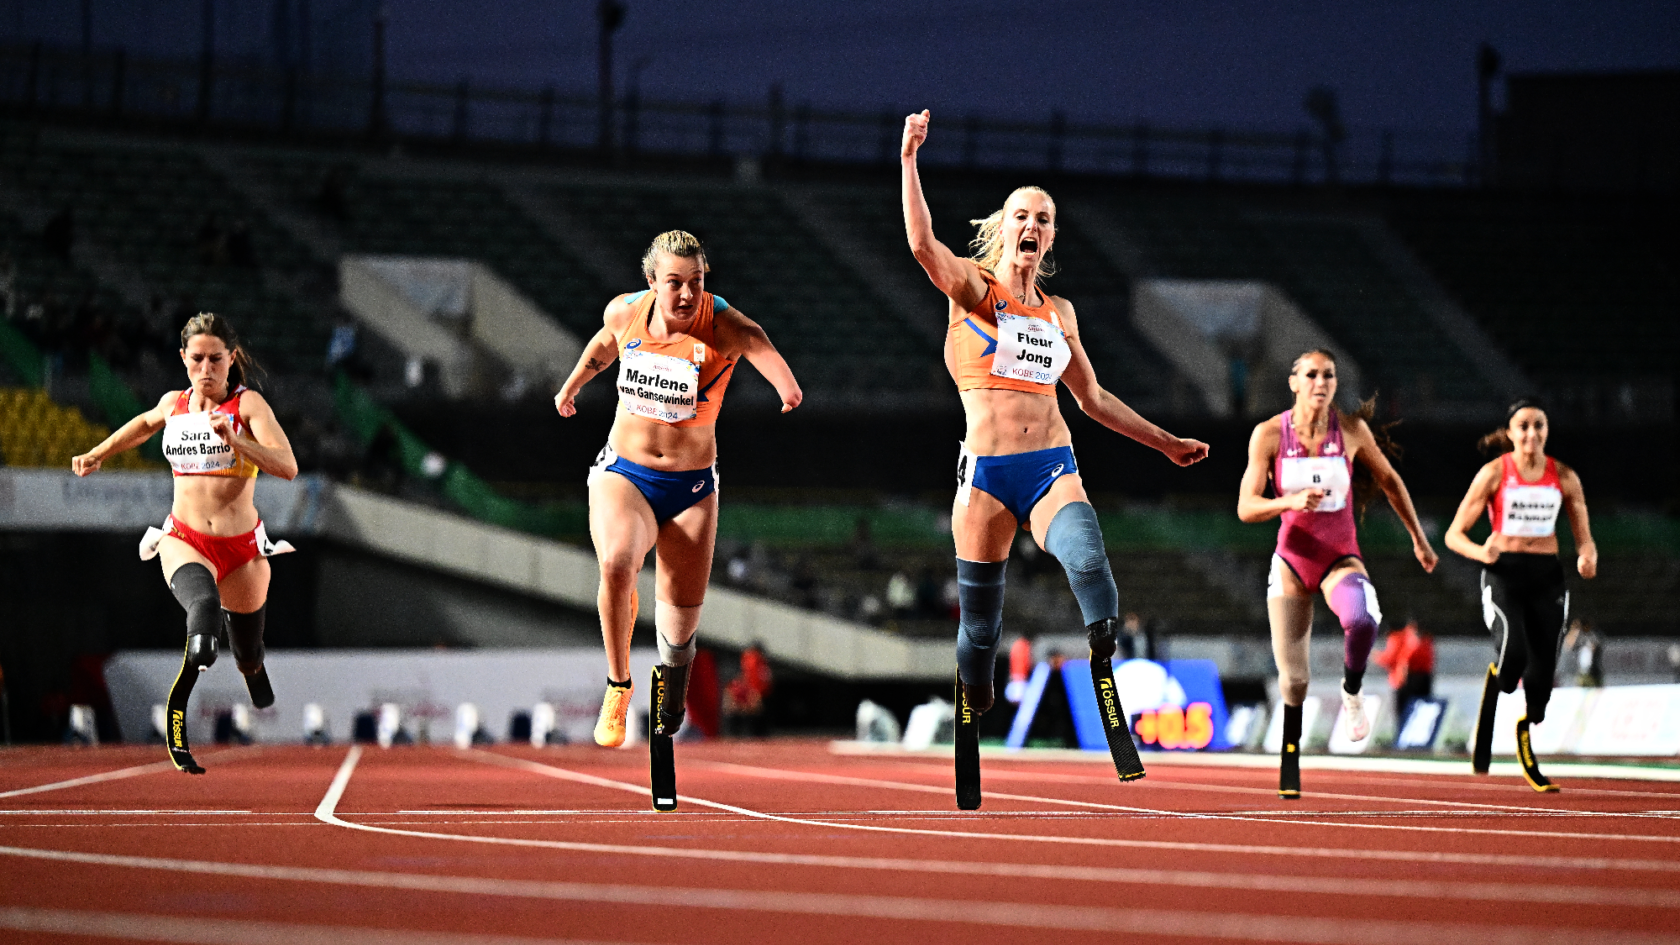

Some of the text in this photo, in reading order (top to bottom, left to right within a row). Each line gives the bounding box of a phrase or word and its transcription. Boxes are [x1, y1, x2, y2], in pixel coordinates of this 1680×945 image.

[1017, 332, 1053, 348] Fleur
[1016, 349, 1053, 368] Jong
[626, 368, 689, 392] Marlene
[1012, 368, 1034, 378] KOBE
[619, 385, 694, 406] van Gansewinkel
[636, 405, 657, 416] KOBE
[181, 430, 210, 441] Sara
[166, 442, 231, 455] Andres Barrio
[201, 461, 220, 470] 2024
[1102, 690, 1120, 729] ÖSSUR
